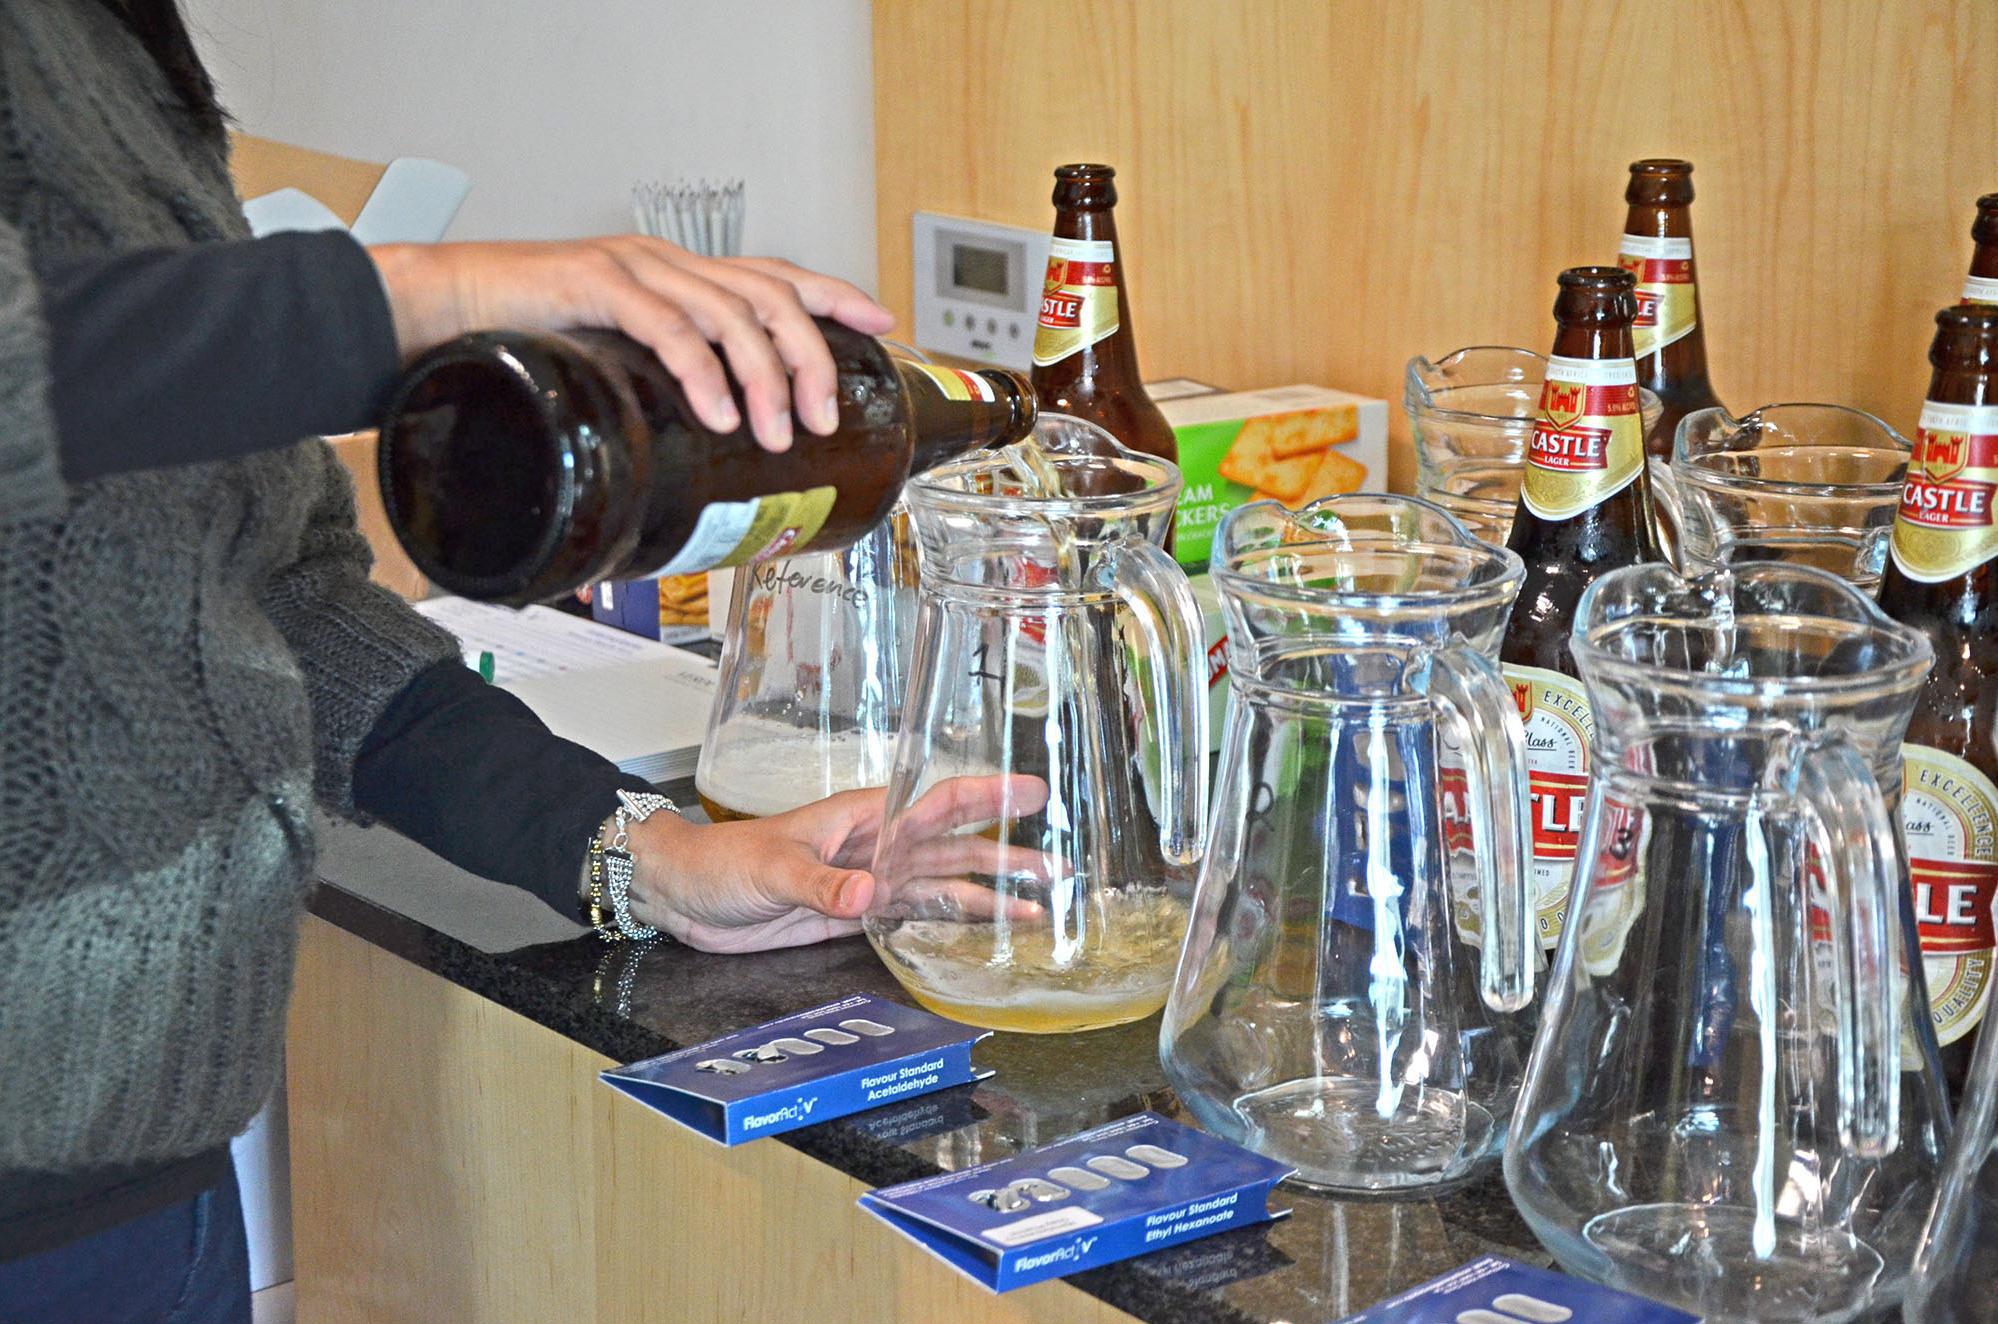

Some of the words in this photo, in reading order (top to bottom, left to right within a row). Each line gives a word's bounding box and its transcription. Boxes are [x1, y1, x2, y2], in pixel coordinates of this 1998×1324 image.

[1532, 431, 1601, 457] CASTLE
[1544, 455, 1569, 466] LAGER
[1903, 483, 1985, 513] CASTLE
[1920, 511, 1949, 523] LAGER
[1920, 769, 1993, 855] EXCELLENCE
[861, 1071, 898, 1090] Flavour
[899, 1057, 945, 1079] Standard
[867, 1073, 939, 1102] Acetaldehyde
[1146, 1208, 1187, 1227] Flavour
[1188, 1192, 1239, 1215] Standard
[1145, 1222, 1173, 1243] Ethyl
[1174, 1208, 1235, 1234] Hexanoate
